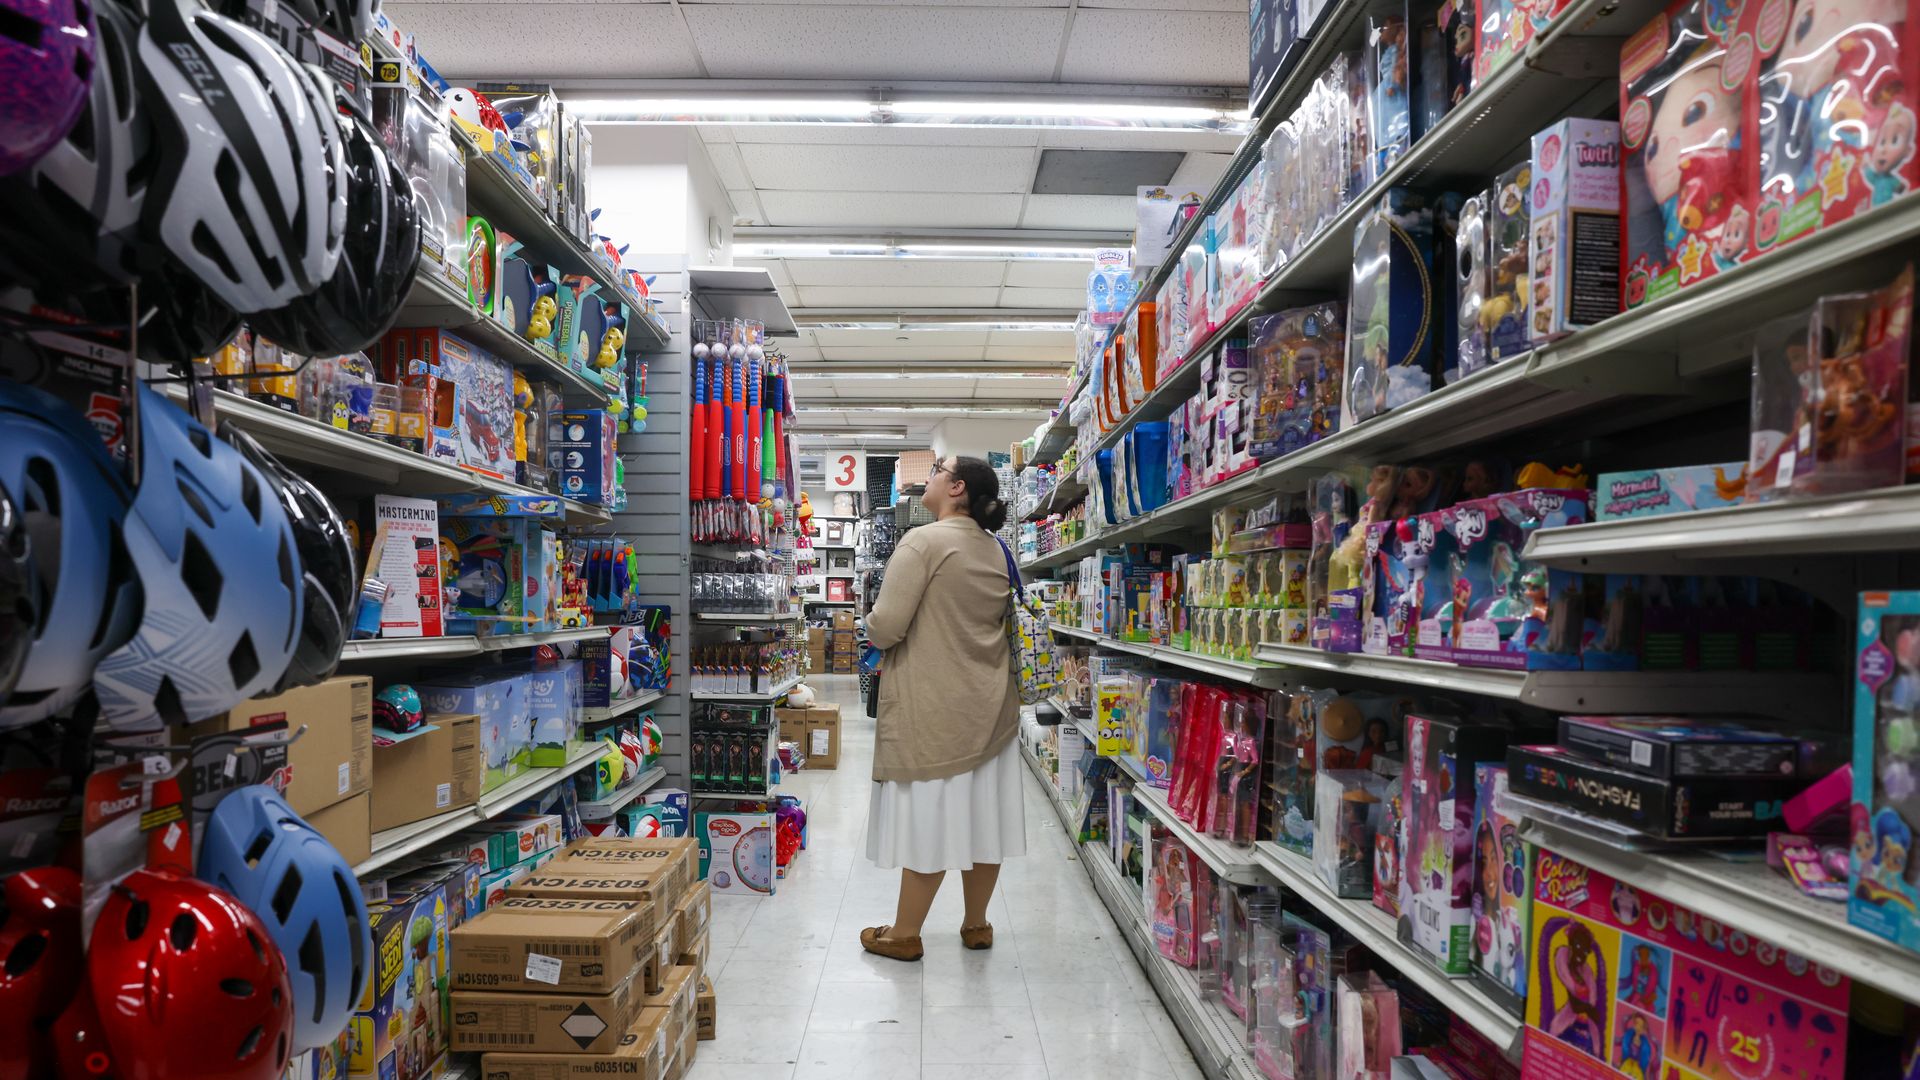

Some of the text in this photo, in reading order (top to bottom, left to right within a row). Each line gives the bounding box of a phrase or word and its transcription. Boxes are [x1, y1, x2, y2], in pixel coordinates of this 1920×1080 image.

[168, 42, 226, 107] BELL
[383, 67, 397, 78] 739
[561, 301, 573, 348] PICKLEBALL
[834, 454, 857, 486] 3
[378, 506, 436, 521] MASTERMIND
[194, 759, 248, 794] BELL
[5, 795, 63, 813] Razor
[100, 794, 140, 817] Razor
[1718, 802, 1744, 811] START
[568, 849, 670, 859] 60351CN
[521, 876, 650, 889] 60351CN
[503, 898, 641, 911] 60351CN
[381, 941, 402, 980] JEDI
[457, 972, 500, 985] 60351CN
[594, 1061, 638, 1073] 60351CN
